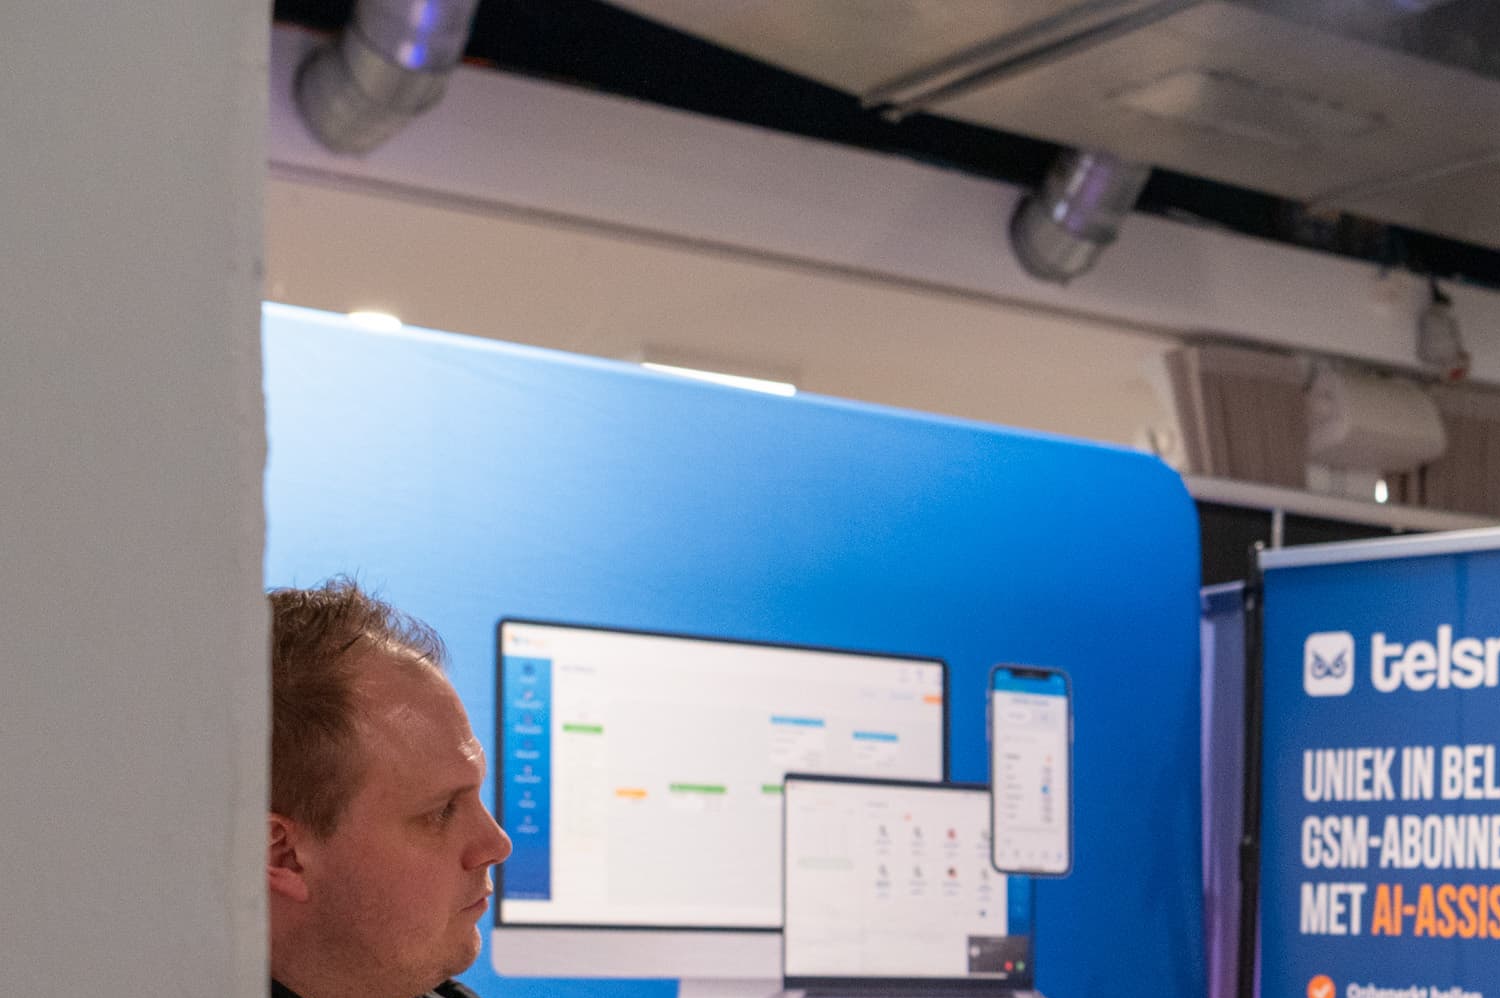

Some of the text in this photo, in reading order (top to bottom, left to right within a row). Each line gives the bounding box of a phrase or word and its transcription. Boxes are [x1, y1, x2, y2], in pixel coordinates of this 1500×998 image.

[1302, 747, 1396, 801] UNIEK
[1402, 746, 1434, 800] IN
[1300, 883, 1367, 935] MET
